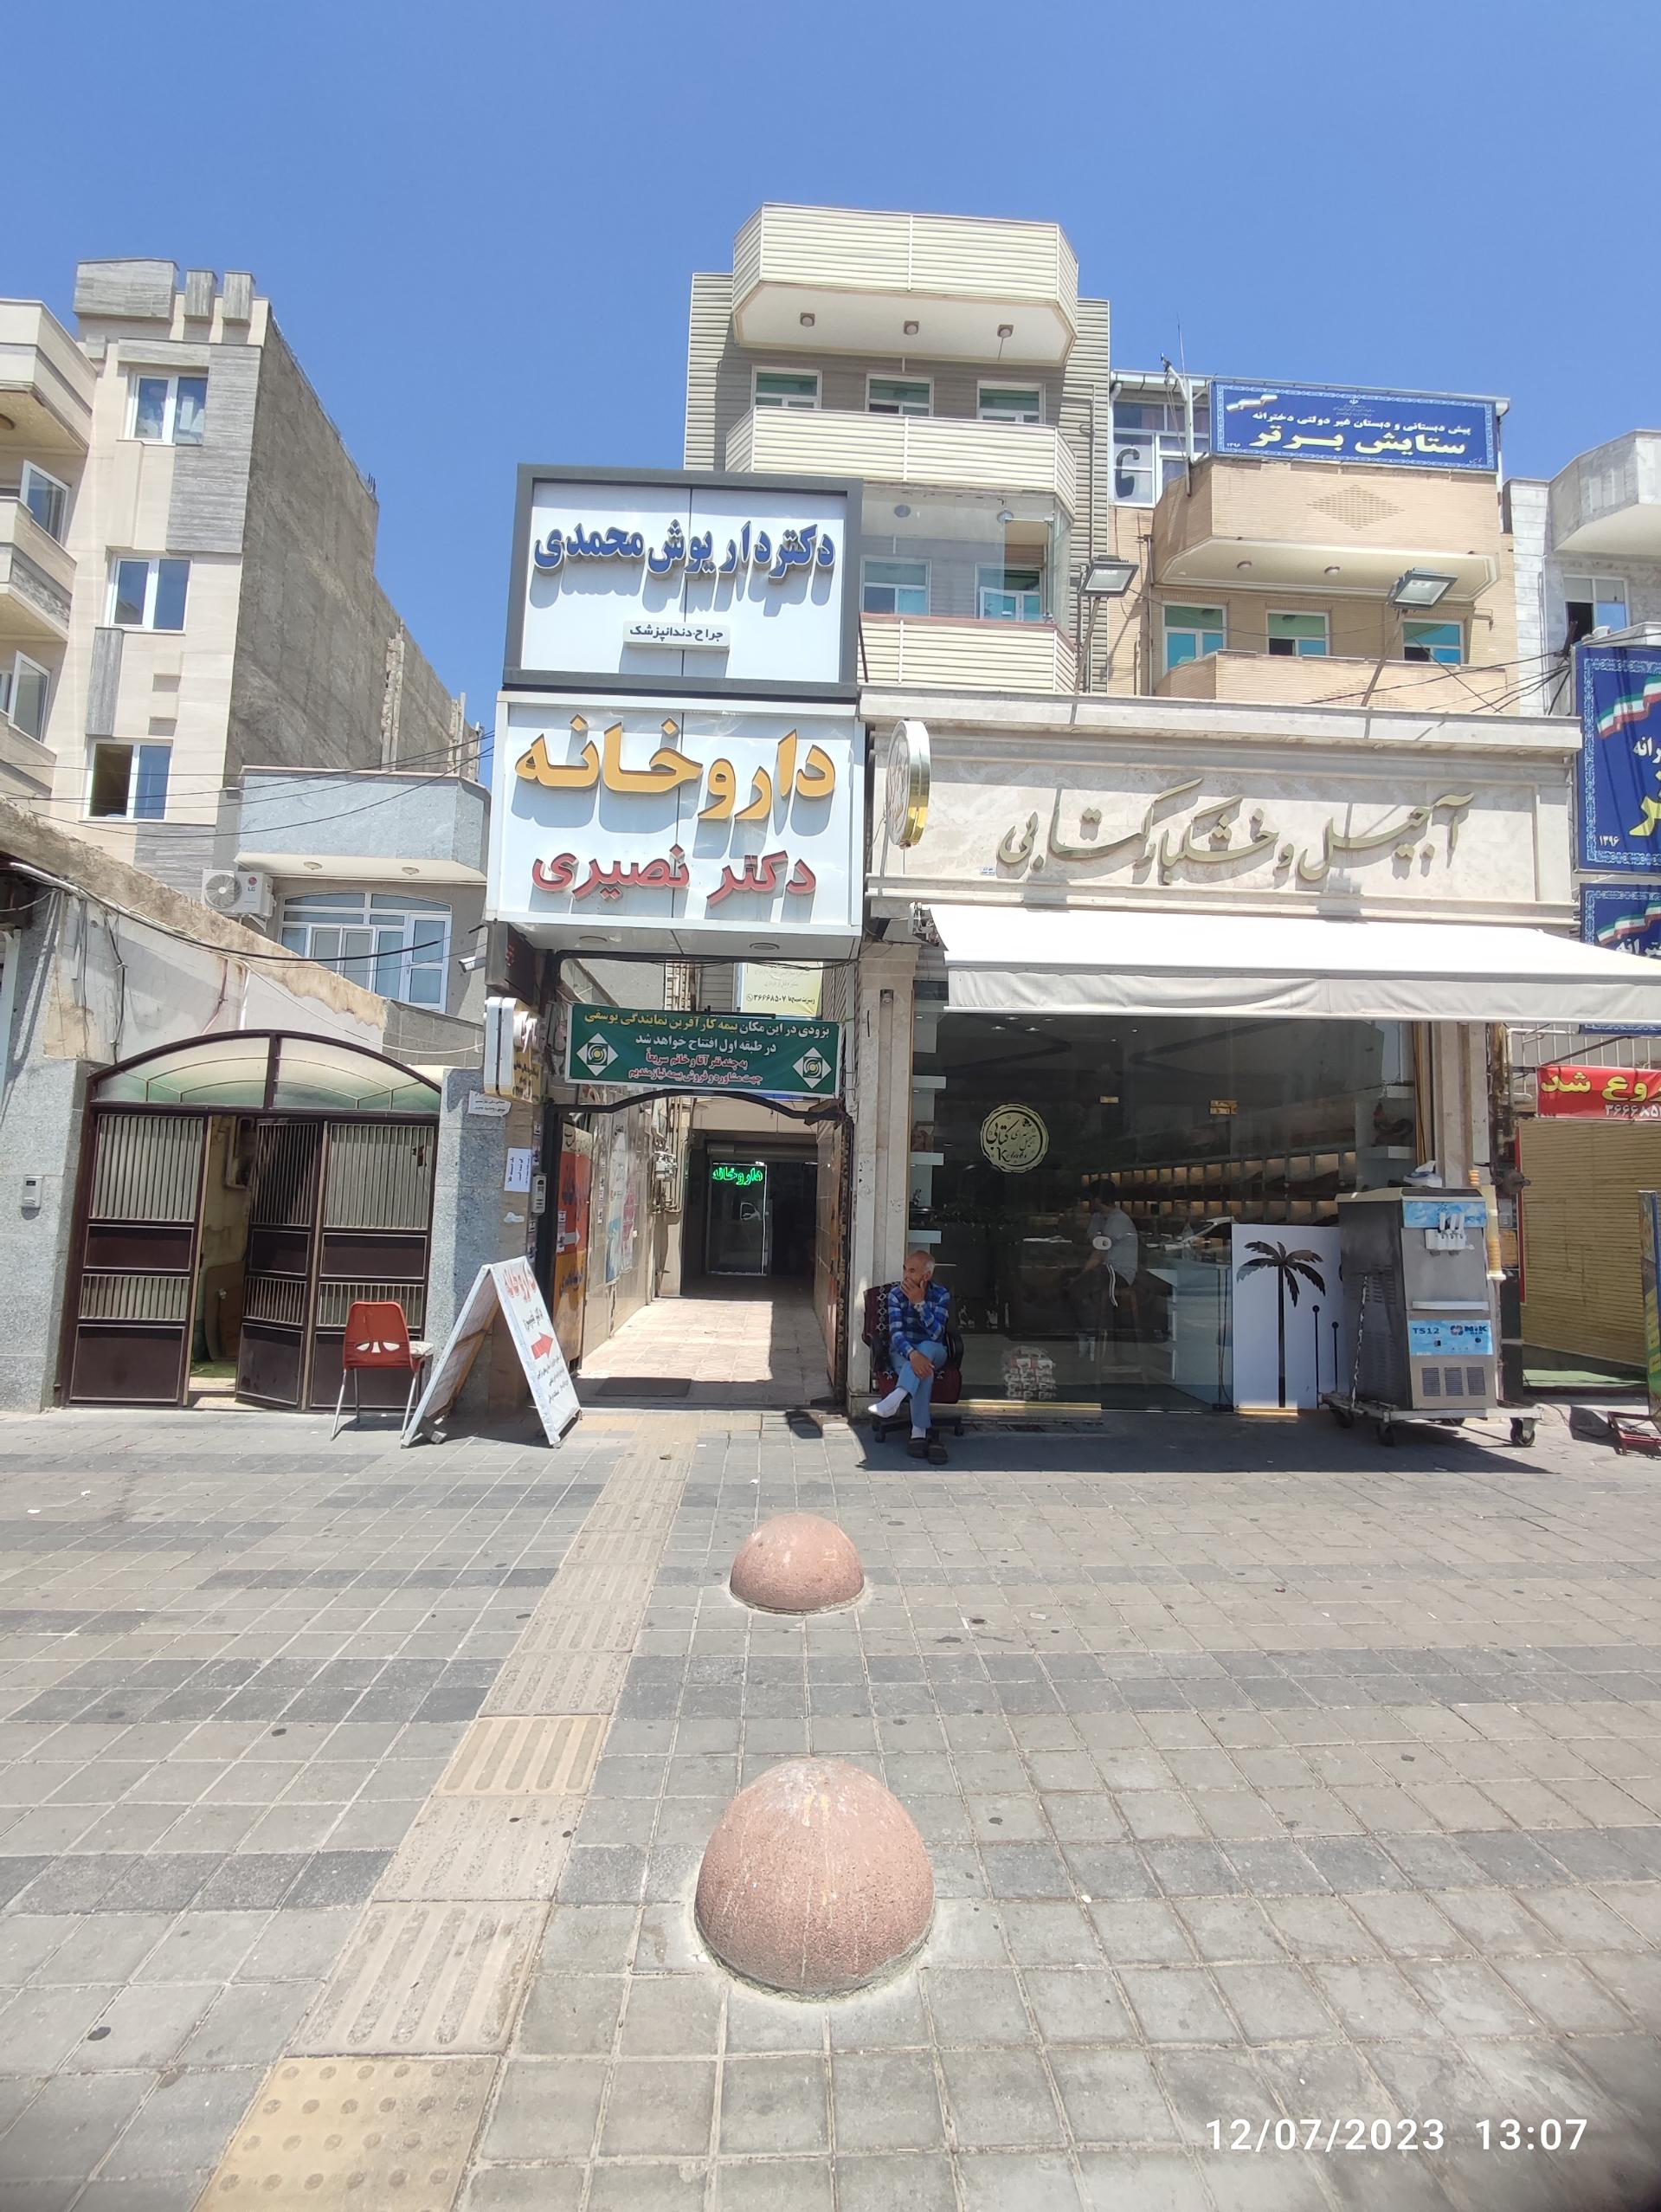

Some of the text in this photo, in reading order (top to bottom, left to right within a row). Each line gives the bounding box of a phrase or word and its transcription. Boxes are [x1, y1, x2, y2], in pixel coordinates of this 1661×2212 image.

[1252, 411, 1294, 422] دخترانه
[1297, 416, 1330, 426] دولتی
[1353, 418, 1391, 429] دبستان
[1402, 422, 1445, 433] دبستانی
[1448, 425, 1471, 435] پیش
[1355, 432, 1465, 455] ستایش
[534, 519, 835, 579] دکتر داریوش محمدی
[629, 624, 724, 642] جراح دندانپزشک
[515, 713, 836, 821] داروخانه
[997, 778, 1203, 873] کتابی
[1133, 794, 1279, 885] خشکبار
[1297, 792, 1475, 880] آجیل
[1600, 835, 1619, 847] ۱۳۹۶
[1276, 843, 1294, 869] و
[531, 843, 816, 908] دکتر نصیری
[584, 1009, 618, 1024] یوسفی
[621, 1012, 667, 1026] نمایندگی
[718, 1022, 737, 1033] بیمه
[739, 1021, 765, 1035] مکان
[766, 1022, 783, 1035] این
[785, 1026, 796, 1036] در
[798, 1027, 829, 1038] بزودی
[635, 1033, 776, 1055] در طبقه اول افتتاح خواهد شد
[670, 1053, 690, 1067] خانم
[690, 1057, 696, 1067] و
[696, 1054, 710, 1066] آقا
[1541, 1072, 1591, 1093] شد
[1606, 1104, 1661, 1117] ۳۶۶۶۸۵
[712, 1167, 763, 1185] داروخانه
